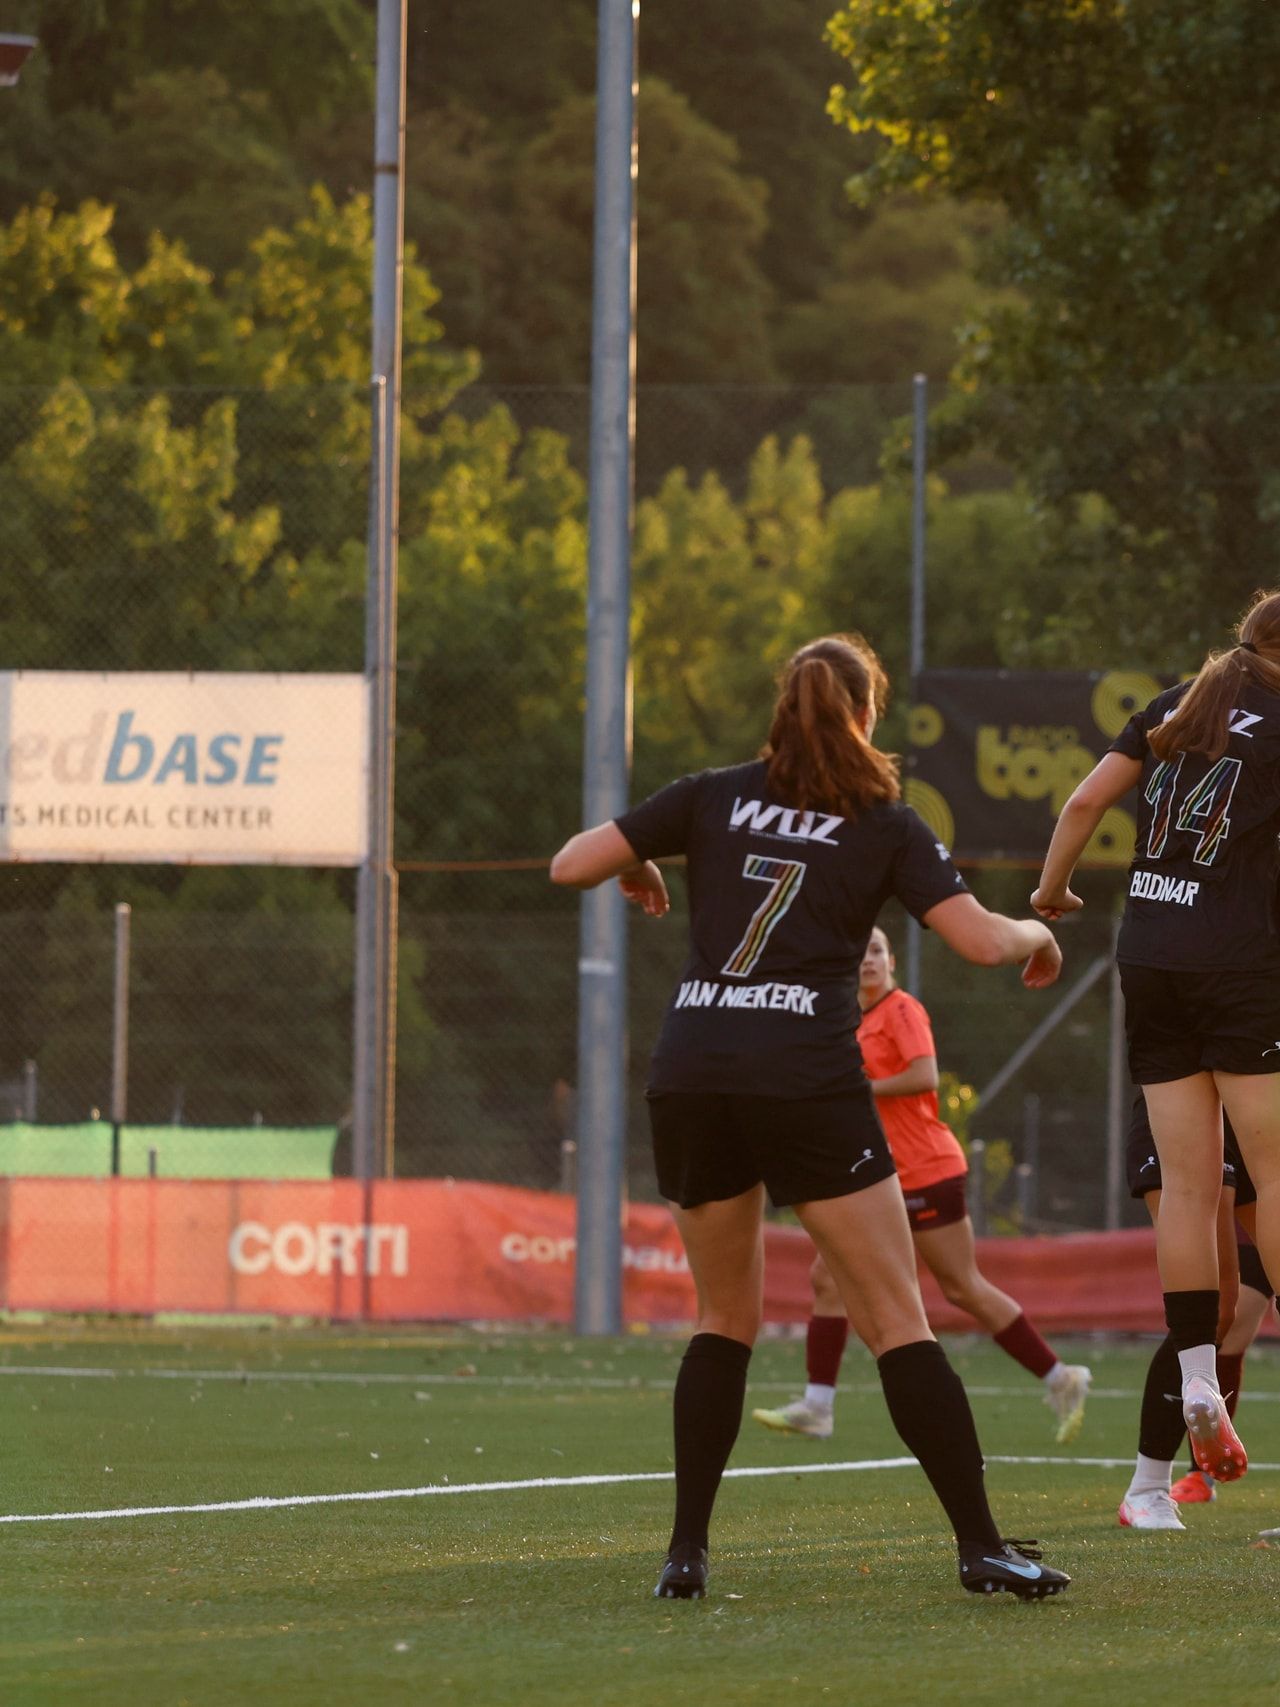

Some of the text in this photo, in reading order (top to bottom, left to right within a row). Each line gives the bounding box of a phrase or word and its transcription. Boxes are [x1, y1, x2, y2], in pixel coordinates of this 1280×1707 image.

[38, 806, 155, 828] MEDICAL
[167, 806, 273, 829] CENTER
[1144, 750, 1243, 866] 14
[1129, 870, 1200, 907] BODNAR
[721, 853, 806, 978] 7
[675, 979, 820, 1017] VAN NIEKERK
[228, 1220, 409, 1277] CORTI
